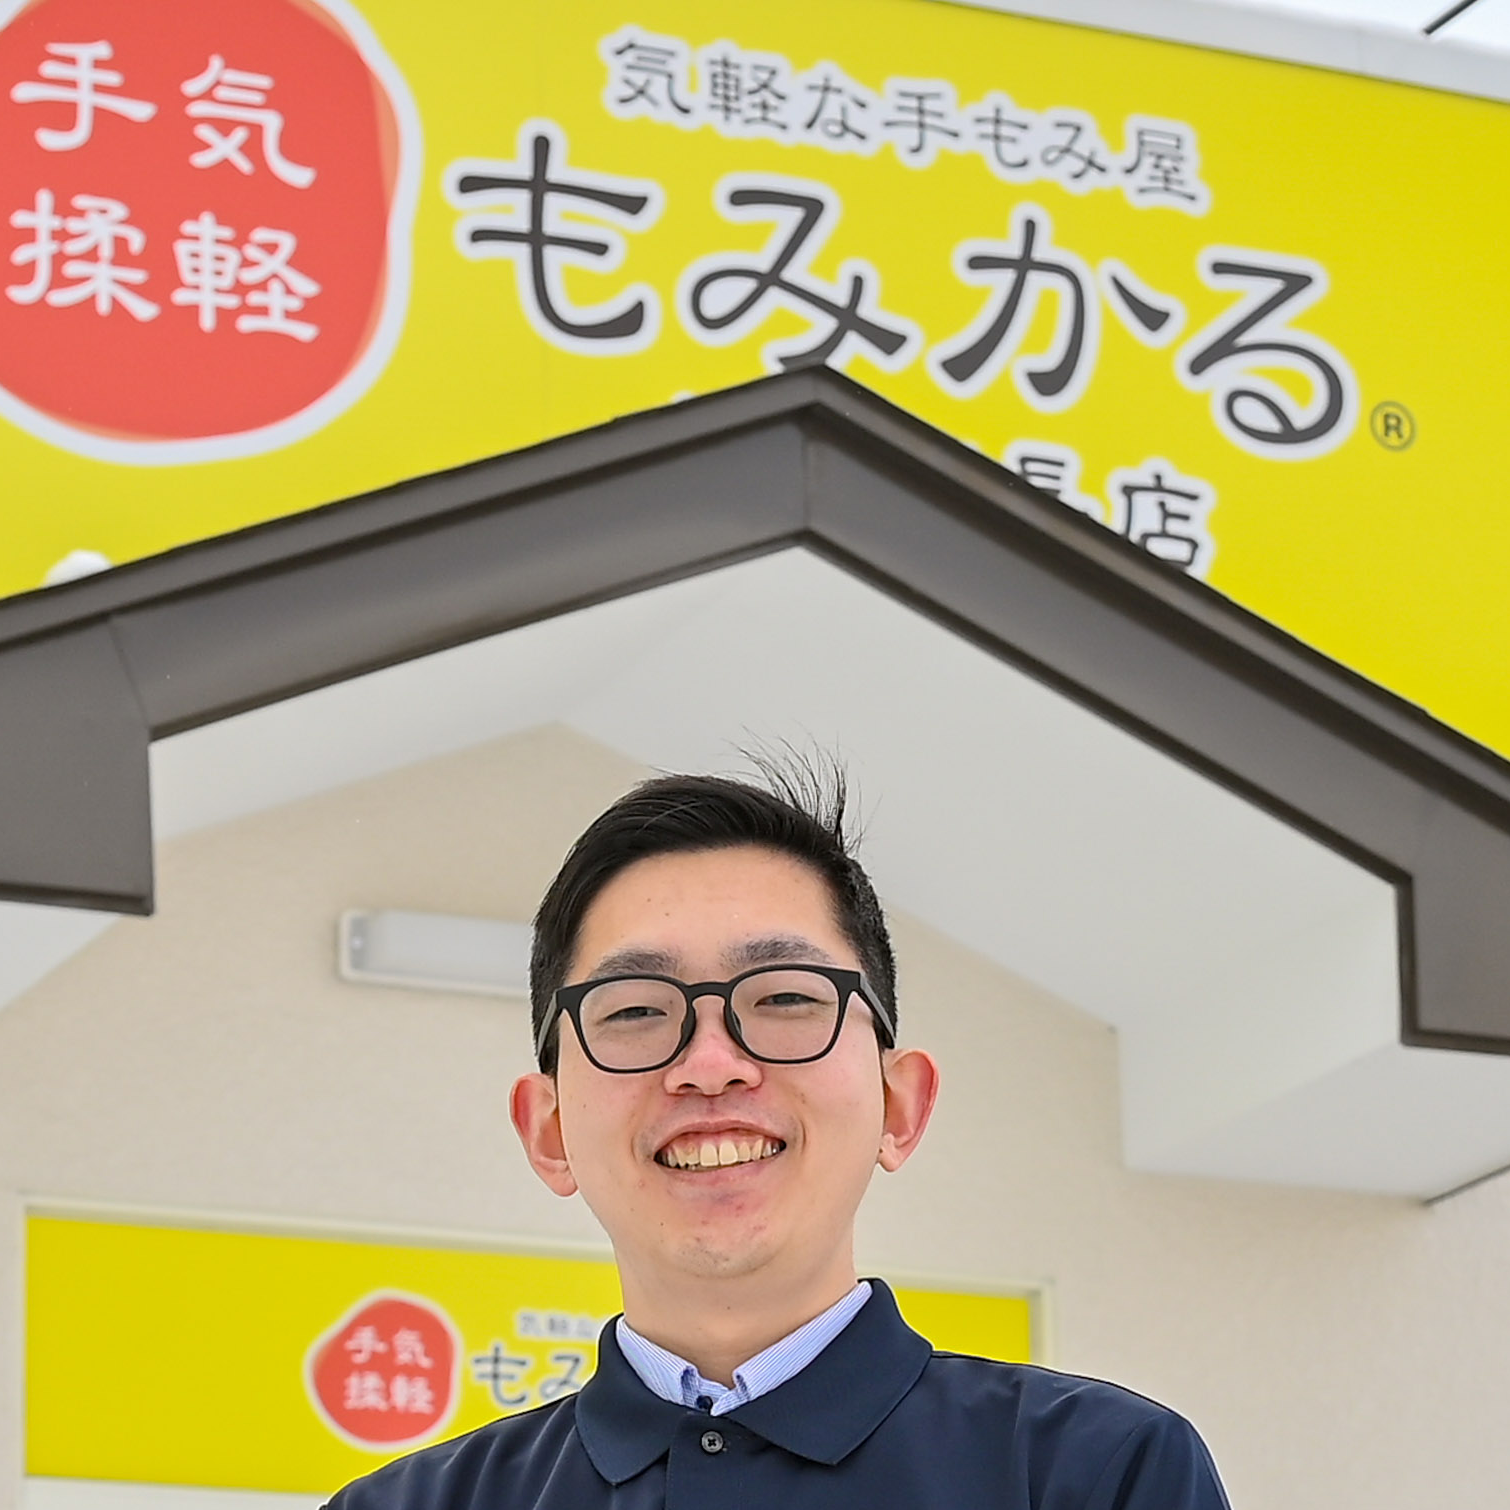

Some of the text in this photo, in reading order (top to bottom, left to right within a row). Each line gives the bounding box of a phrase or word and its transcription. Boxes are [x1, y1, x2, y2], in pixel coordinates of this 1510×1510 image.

[614, 40, 1199, 203] 気軽な手もみ屋
[458, 135, 1344, 444] もみかる
